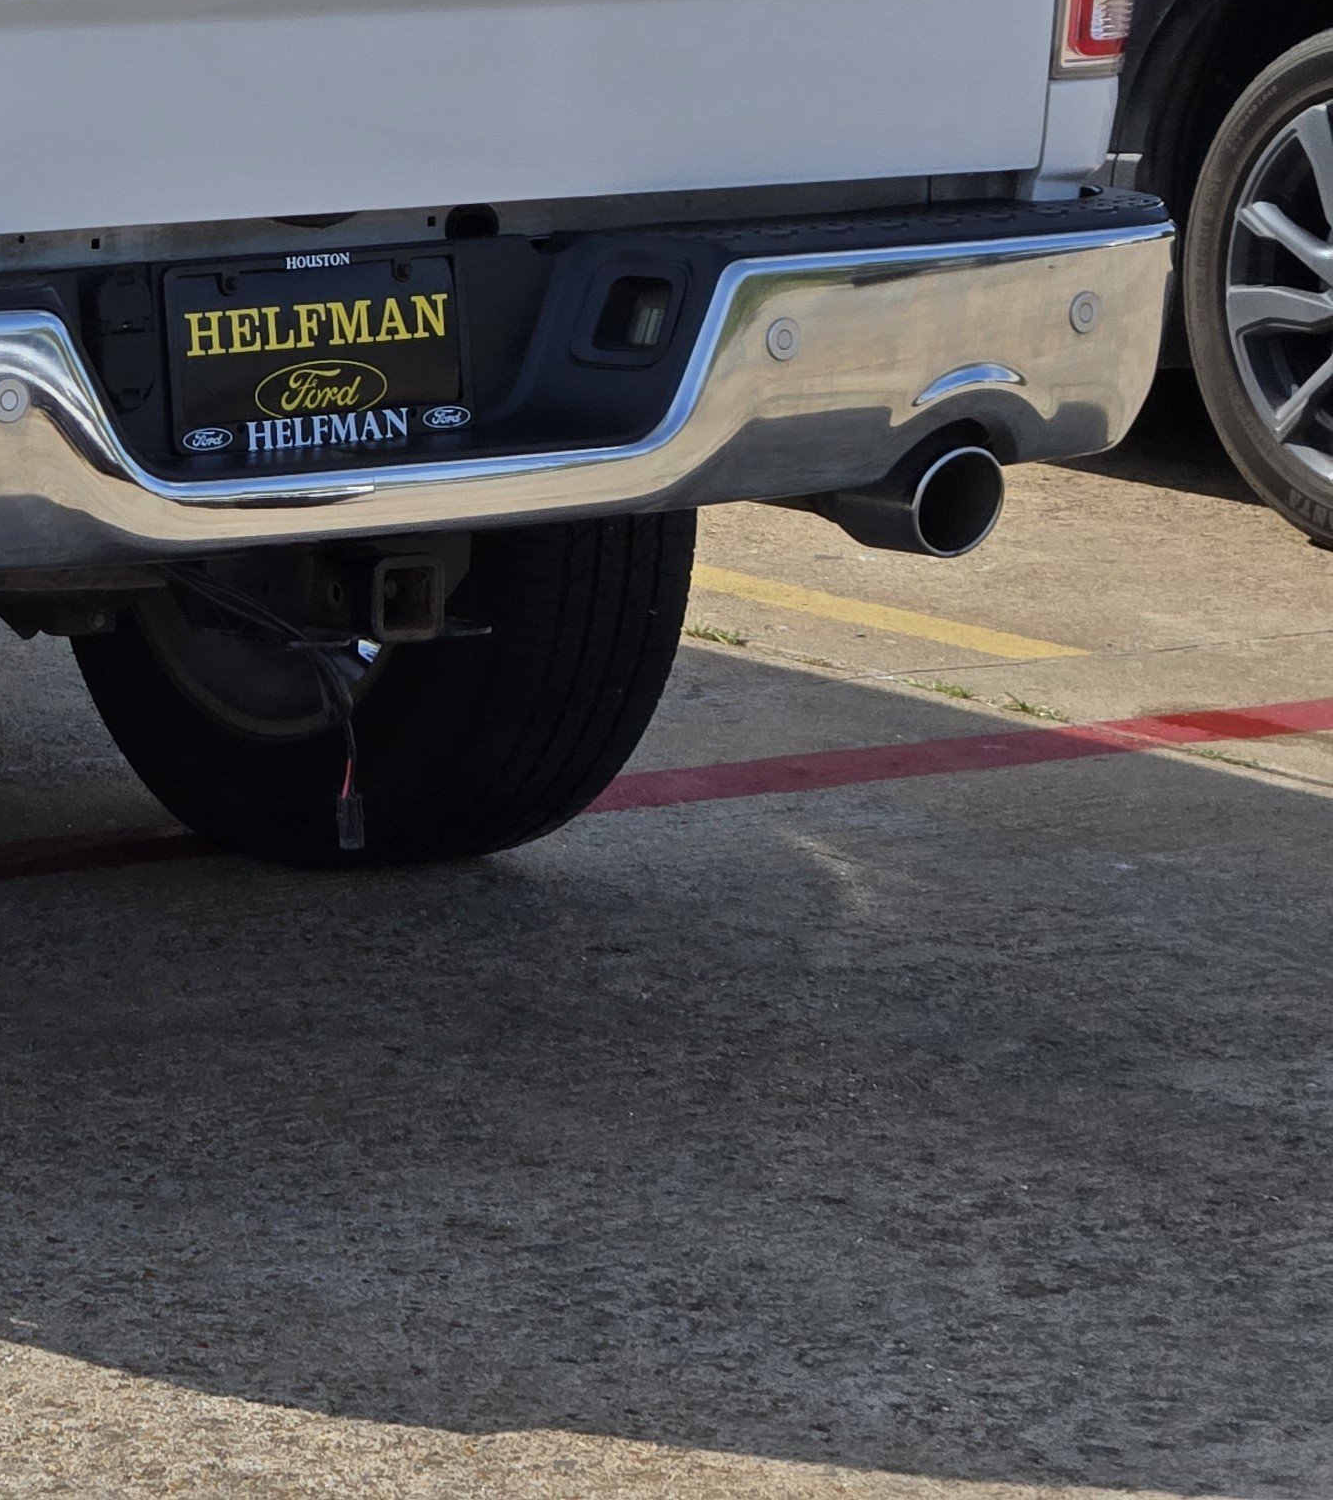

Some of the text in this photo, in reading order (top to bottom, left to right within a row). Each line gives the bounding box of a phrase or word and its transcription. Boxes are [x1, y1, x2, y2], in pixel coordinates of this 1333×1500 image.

[286, 252, 352, 270] HOUSTON
[184, 293, 448, 357] HELFMAN
[281, 368, 362, 411] Ford
[192, 408, 462, 451] Ford HELFMAN Ford
